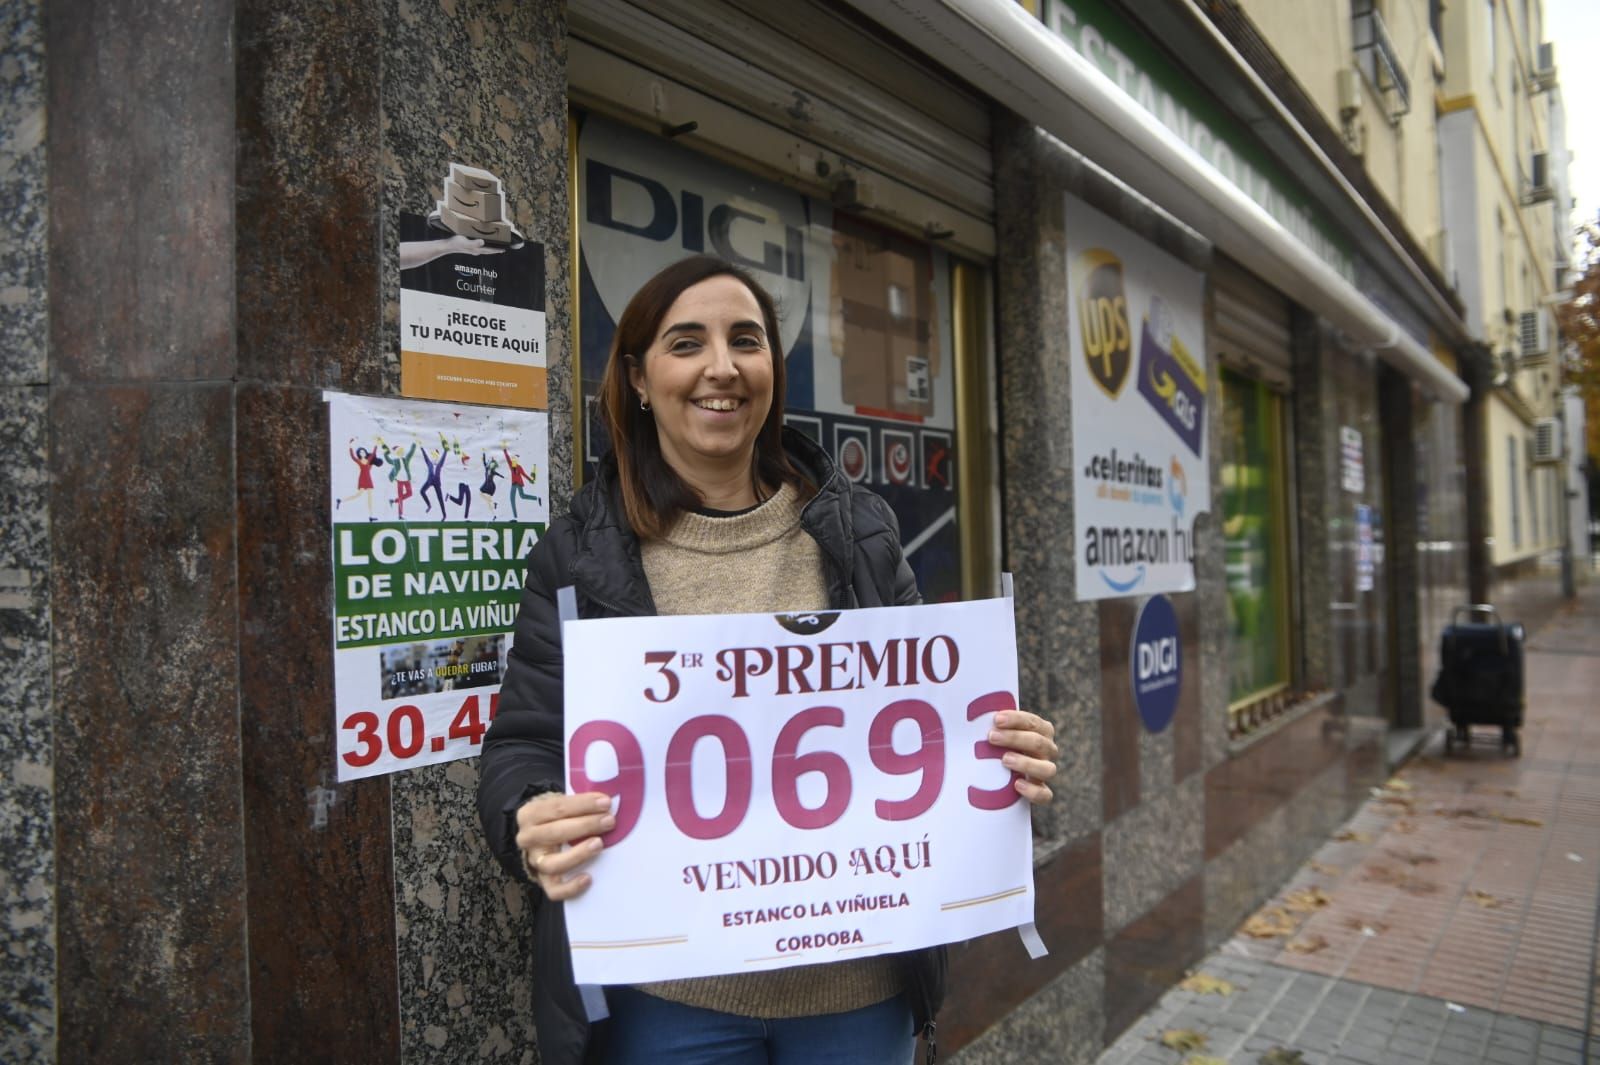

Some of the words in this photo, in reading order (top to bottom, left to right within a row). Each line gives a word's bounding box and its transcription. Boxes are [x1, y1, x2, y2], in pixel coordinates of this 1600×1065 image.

[587, 158, 804, 282] DIGI
[454, 264, 482, 275] amazon
[483, 267, 498, 279] hub
[456, 279, 497, 296] Counter
[410, 324, 430, 339] TU
[434, 328, 499, 348] PAQUETE
[502, 338, 539, 354] AQUÍ!
[447, 311, 506, 331] ¡RECOGE
[340, 528, 540, 566] LOTERIA
[1086, 526, 1169, 566] amazon
[347, 573, 393, 600] DE
[404, 568, 528, 596] NAVIDA
[337, 609, 435, 642] ESTANCO
[440, 608, 465, 632] LA
[466, 600, 521, 630] VIÑU
[408, 669, 425, 681] VAS
[428, 667, 434, 678] A
[435, 664, 468, 678] QUEDAR
[471, 660, 498, 674] FUERA?
[716, 635, 960, 699] PREMIO
[1138, 636, 1177, 680] DIGI
[569, 690, 1023, 849] 90693
[683, 851, 838, 892] VENDIDO
[849, 833, 932, 879] AQUÍ
[723, 905, 806, 927] ESTANCO
[811, 903, 832, 917] LA
[836, 893, 910, 914] VIÑUELA
[775, 929, 864, 952] CORDOBA
